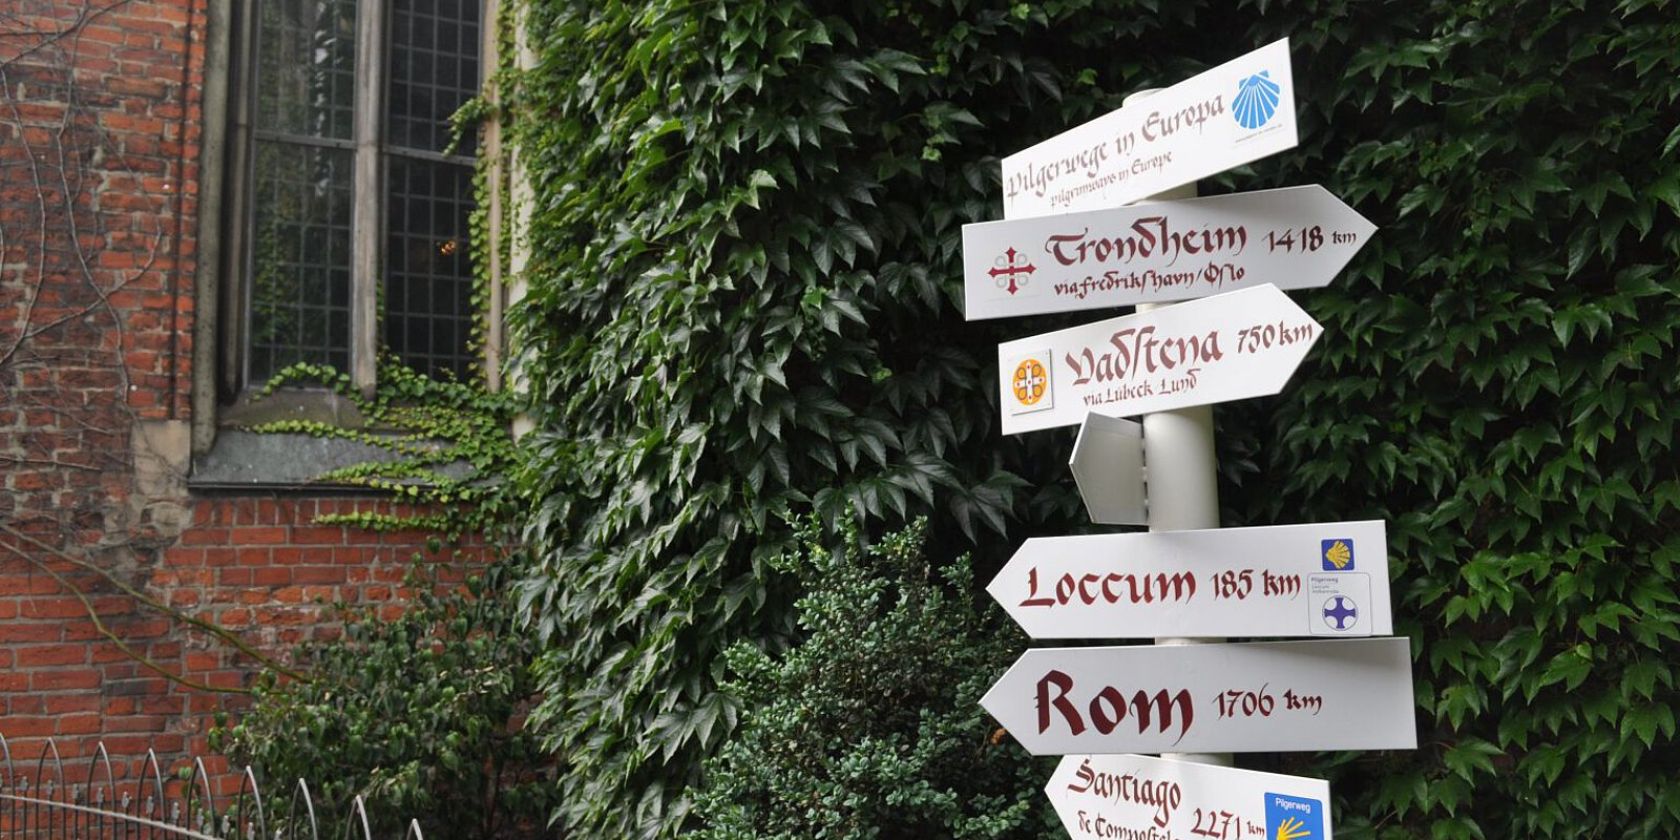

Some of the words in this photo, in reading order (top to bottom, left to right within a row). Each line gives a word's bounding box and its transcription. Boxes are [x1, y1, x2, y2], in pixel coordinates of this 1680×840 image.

[1116, 132, 1135, 156] in
[1142, 95, 1225, 142] Europa
[1119, 168, 1129, 182] in
[1131, 151, 1172, 175] Europe
[1045, 216, 1247, 267] Trondheim
[1261, 225, 1324, 254] 1418
[1332, 230, 1357, 245] km
[1054, 281, 1078, 296] via
[1065, 325, 1223, 386] Vadstena
[1237, 325, 1275, 354] 750
[1278, 319, 1314, 346] km
[1083, 393, 1103, 406] via
[1157, 368, 1202, 395] Lund
[1018, 566, 1197, 608] Loccum
[1211, 569, 1255, 599] 185
[1262, 569, 1302, 600] km
[1034, 669, 1195, 747] Rom
[1212, 683, 1275, 718] 1706
[1284, 688, 1323, 716] km
[1067, 758, 1182, 828] Santiago
[1275, 797, 1311, 814] Pilgerweg
[1190, 808, 1240, 840] 2271
[1246, 820, 1265, 837] km
